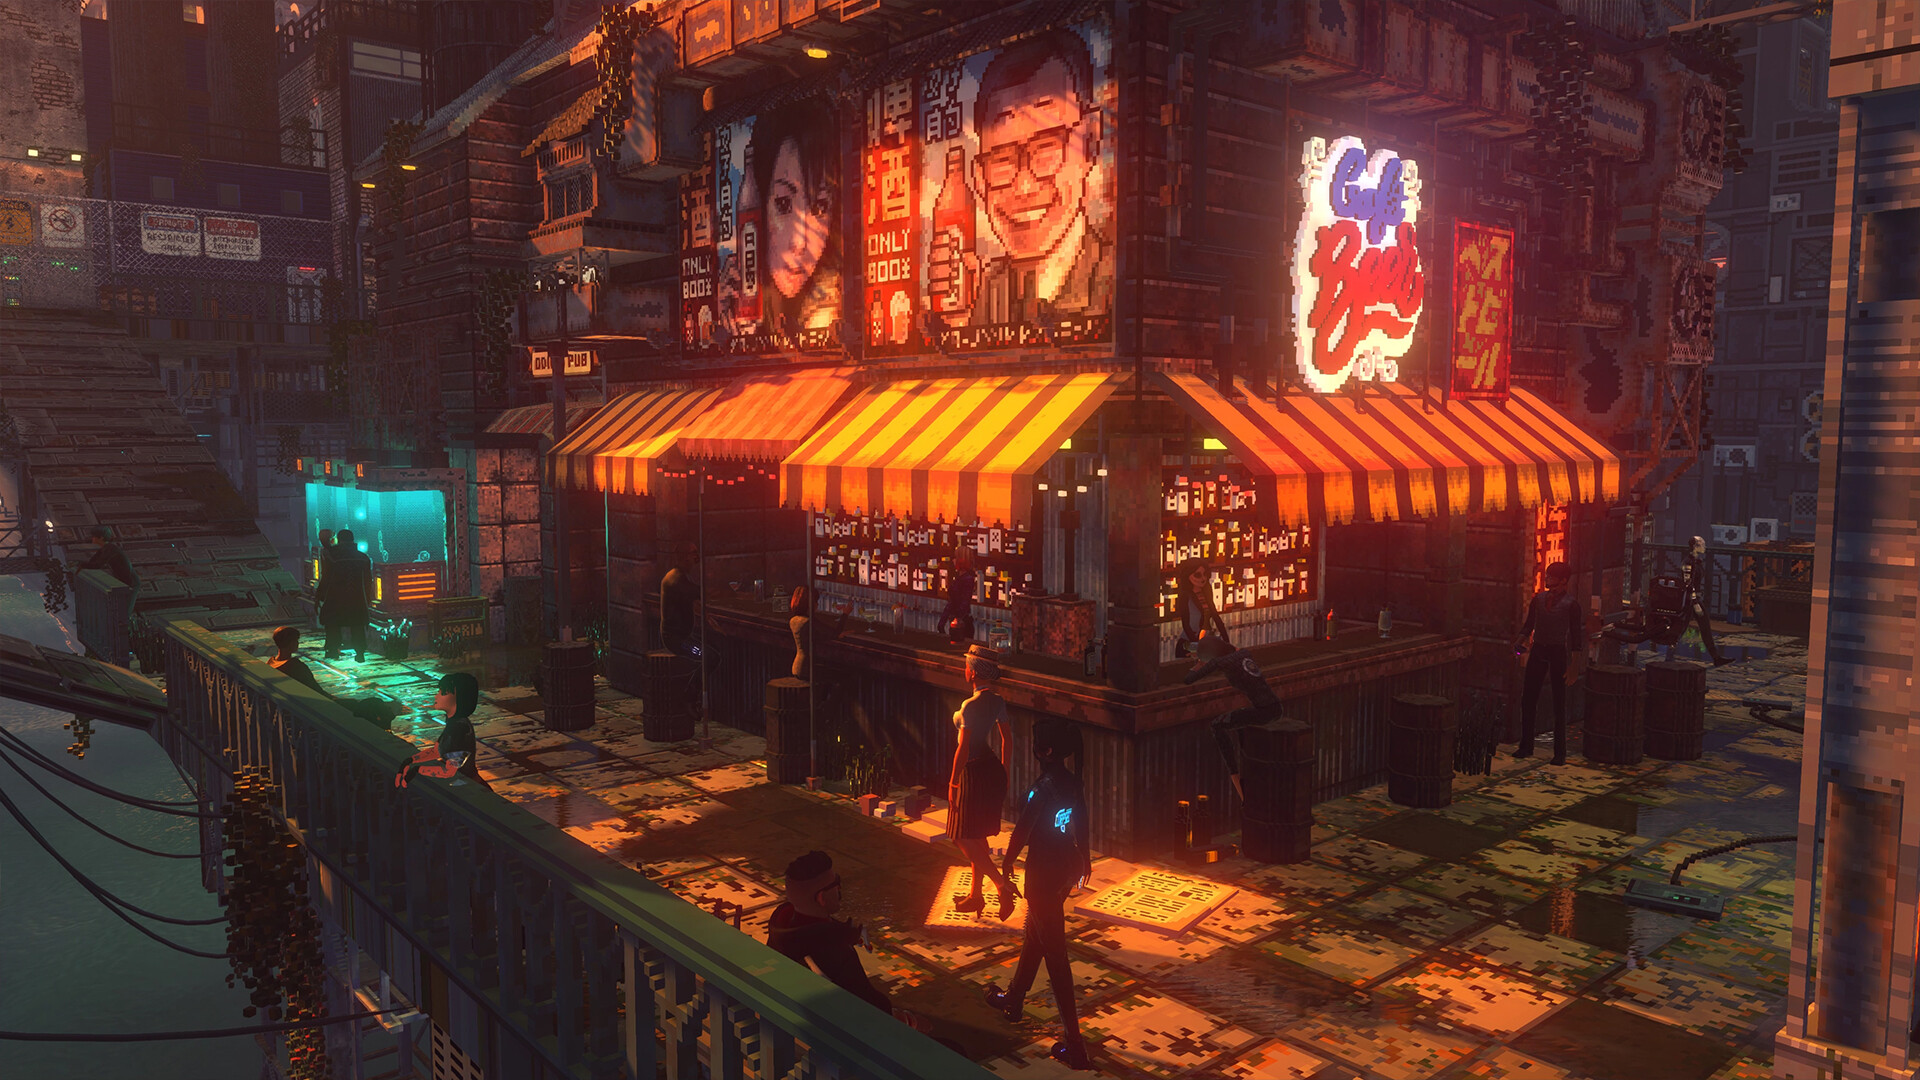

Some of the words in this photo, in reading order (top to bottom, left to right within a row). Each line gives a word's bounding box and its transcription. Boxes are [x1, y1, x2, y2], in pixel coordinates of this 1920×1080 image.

[867, 228, 910, 256] ONLY
[682, 254, 711, 277] ONLY
[567, 353, 588, 368] PUB
